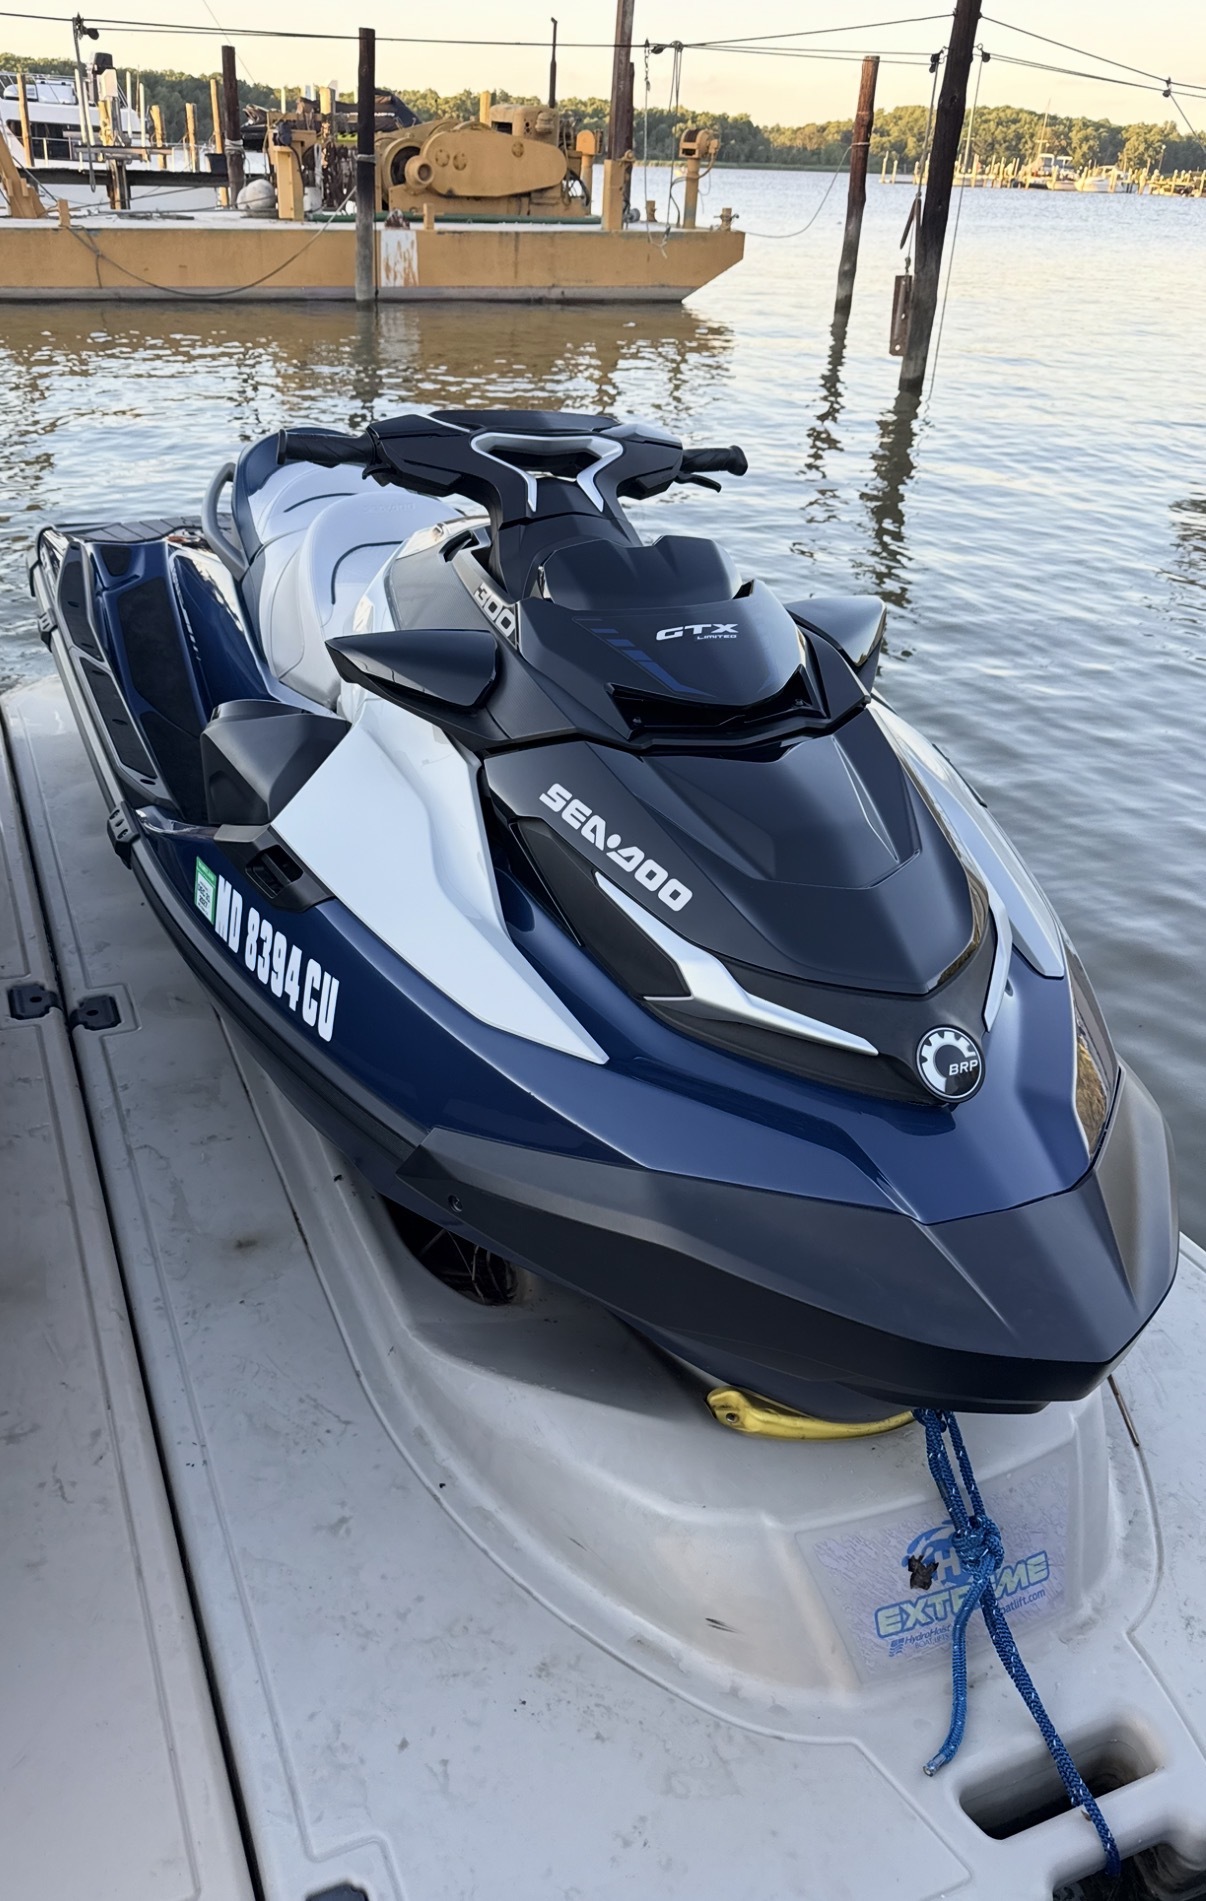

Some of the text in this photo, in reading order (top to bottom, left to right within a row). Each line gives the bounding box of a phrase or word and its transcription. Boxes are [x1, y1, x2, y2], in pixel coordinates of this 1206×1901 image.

[474, 581, 516, 638] 300
[656, 623, 739, 641] GTX
[214, 874, 243, 953] MD
[949, 1059, 978, 1076] BRP
[874, 1551, 1050, 1638] EXTME
[1000, 1588, 1046, 1614] oatlift.com
